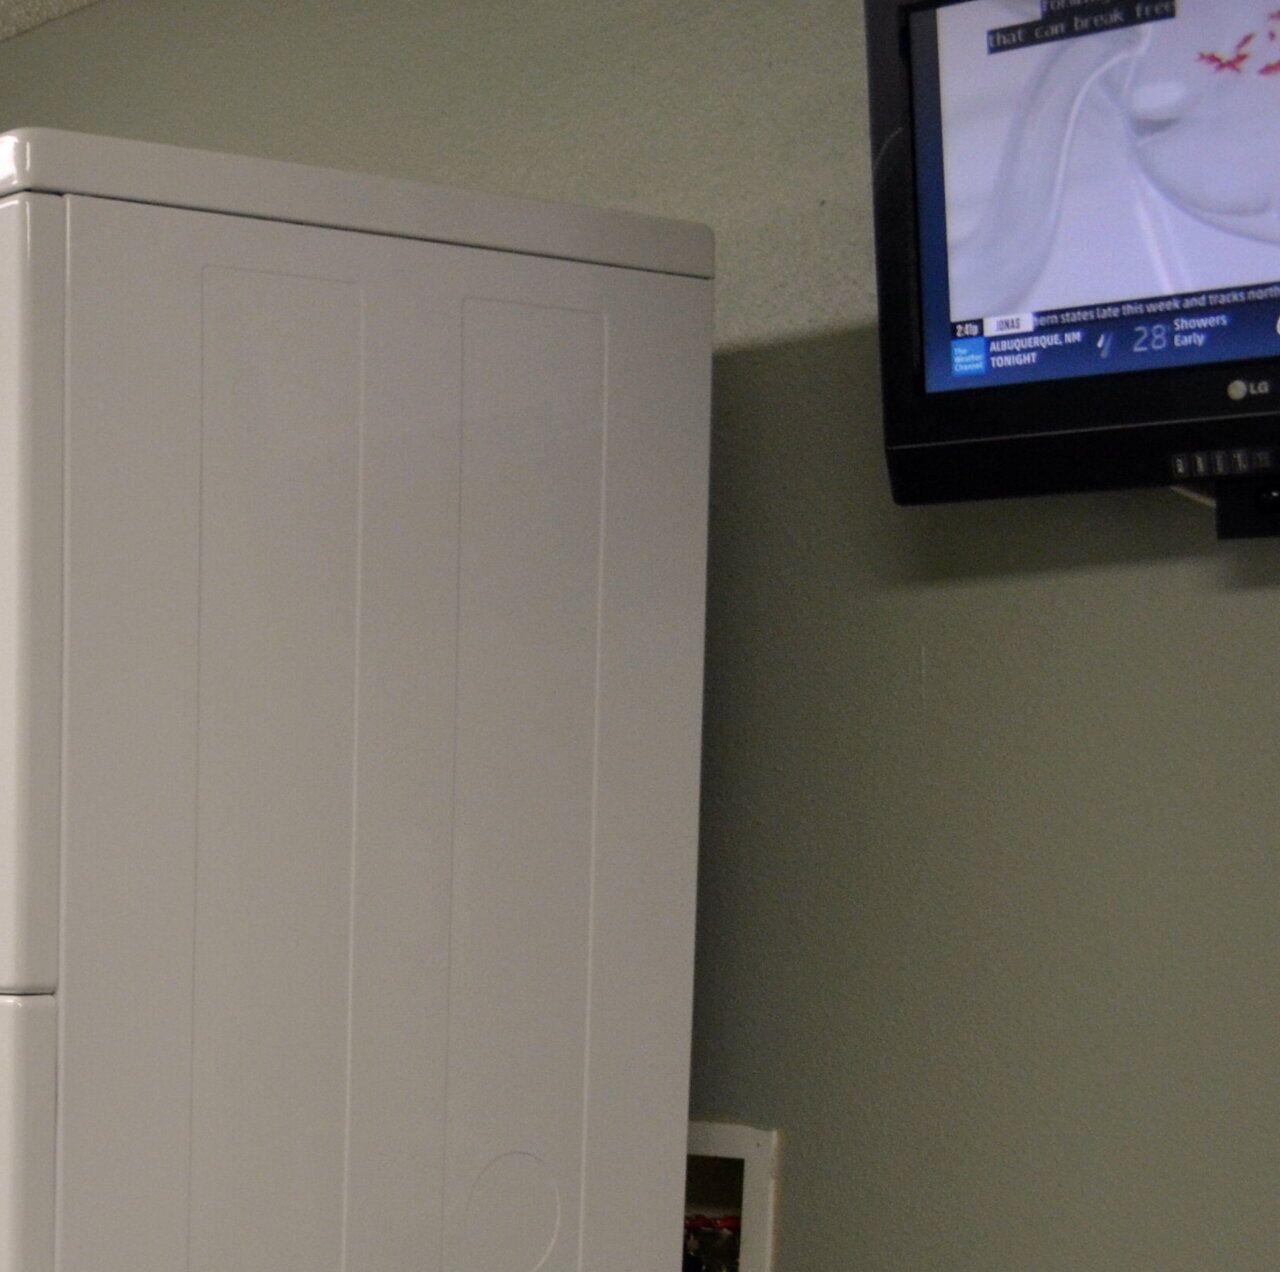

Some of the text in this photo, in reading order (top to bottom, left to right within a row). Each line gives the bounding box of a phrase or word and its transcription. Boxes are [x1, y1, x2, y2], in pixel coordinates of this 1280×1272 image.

[988, 28, 1024, 49] that
[1034, 21, 1066, 39] can
[1073, 8, 1124, 32] break
[1061, 309, 1095, 325] states
[1096, 305, 1120, 321] late
[1121, 302, 1144, 316] this
[1145, 298, 1181, 313] week
[1182, 294, 1206, 309] and
[1208, 291, 1246, 306] tracks
[996, 318, 1021, 332] JONAS
[1173, 314, 1228, 331] Showers
[1064, 331, 1082, 344] NM
[1132, 324, 1167, 353] 28
[1173, 333, 1205, 348] Early
[990, 352, 1037, 368] TONIGHT
[1249, 381, 1269, 395] LG
